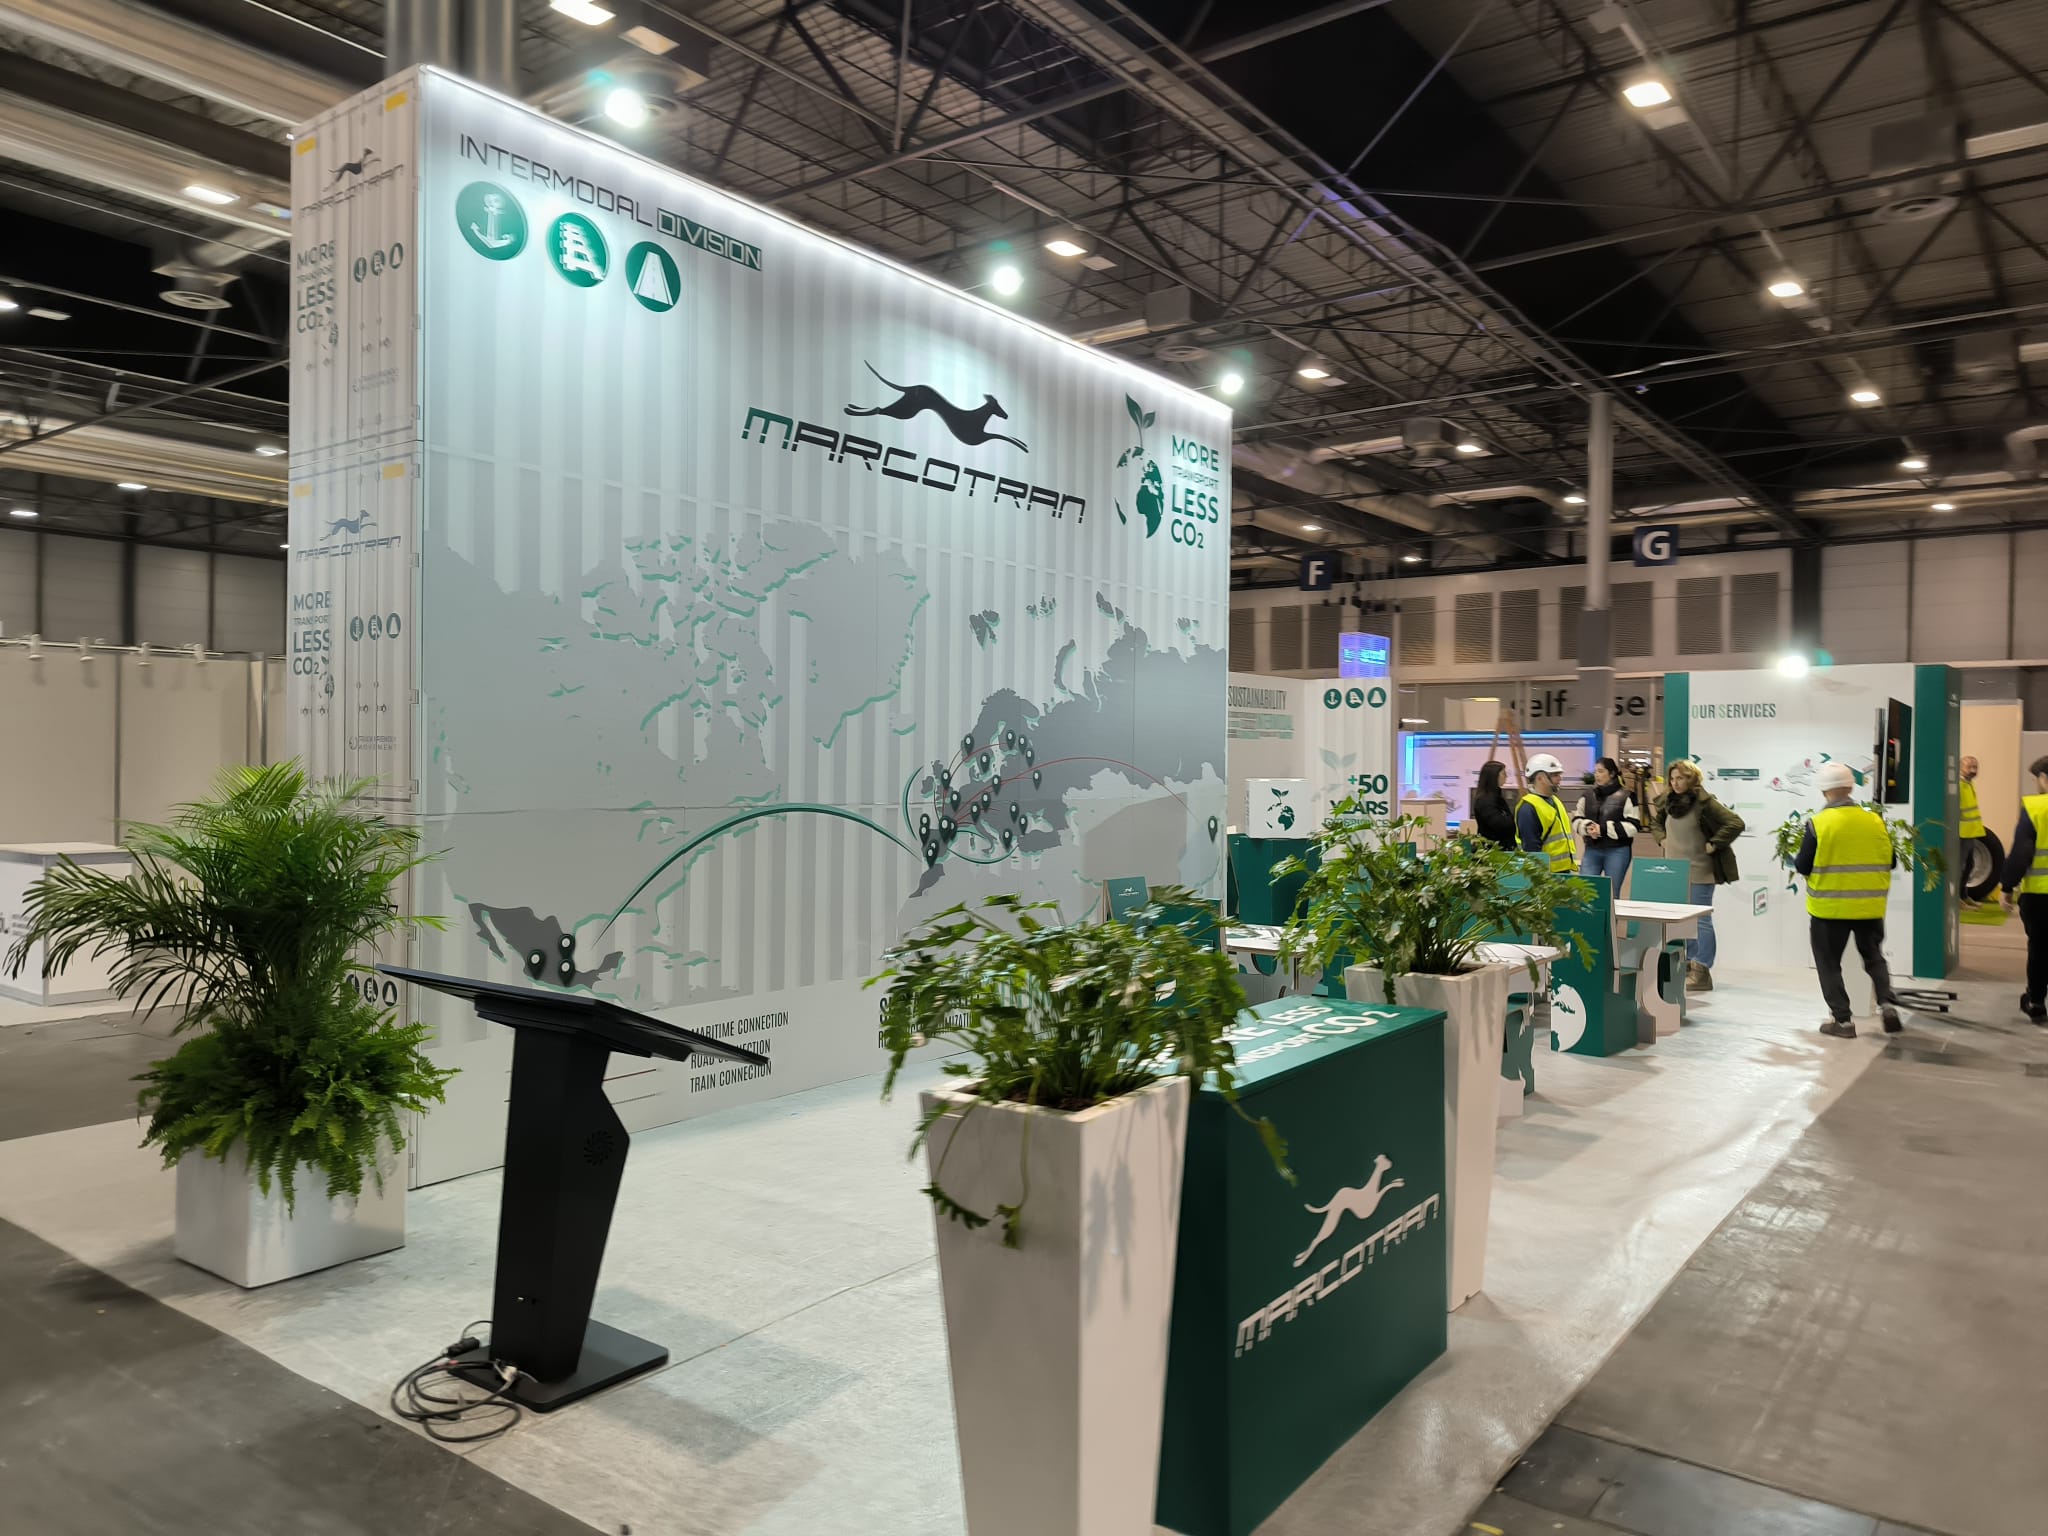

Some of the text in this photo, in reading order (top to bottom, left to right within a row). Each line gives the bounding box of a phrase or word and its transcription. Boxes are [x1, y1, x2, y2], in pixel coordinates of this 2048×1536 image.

[460, 133, 761, 270] INTERMODAL DIVISION
[296, 240, 335, 270] MORE
[296, 279, 336, 311] LESS
[297, 311, 323, 333] CO2
[741, 406, 1087, 525] MARCOTRAN
[1171, 434, 1220, 472] MORE
[1171, 484, 1219, 524] LESS
[1171, 518, 1204, 549] CO2
[1641, 530, 1671, 561] G
[1308, 560, 1324, 586] F
[293, 590, 331, 611] MORE
[293, 629, 332, 653] LESS
[293, 656, 320, 675] CO2
[1691, 703, 1777, 719] OUR SERVICES
[1347, 774, 1389, 795] +50
[737, 1011, 789, 1035] CONNECTION
[1262, 1005, 1334, 1026] LESS
[1301, 1010, 1401, 1036] CO2
[690, 1060, 772, 1093] TRAIN CONNECTION
[1234, 1192, 1440, 1359] MARCOTRAN
